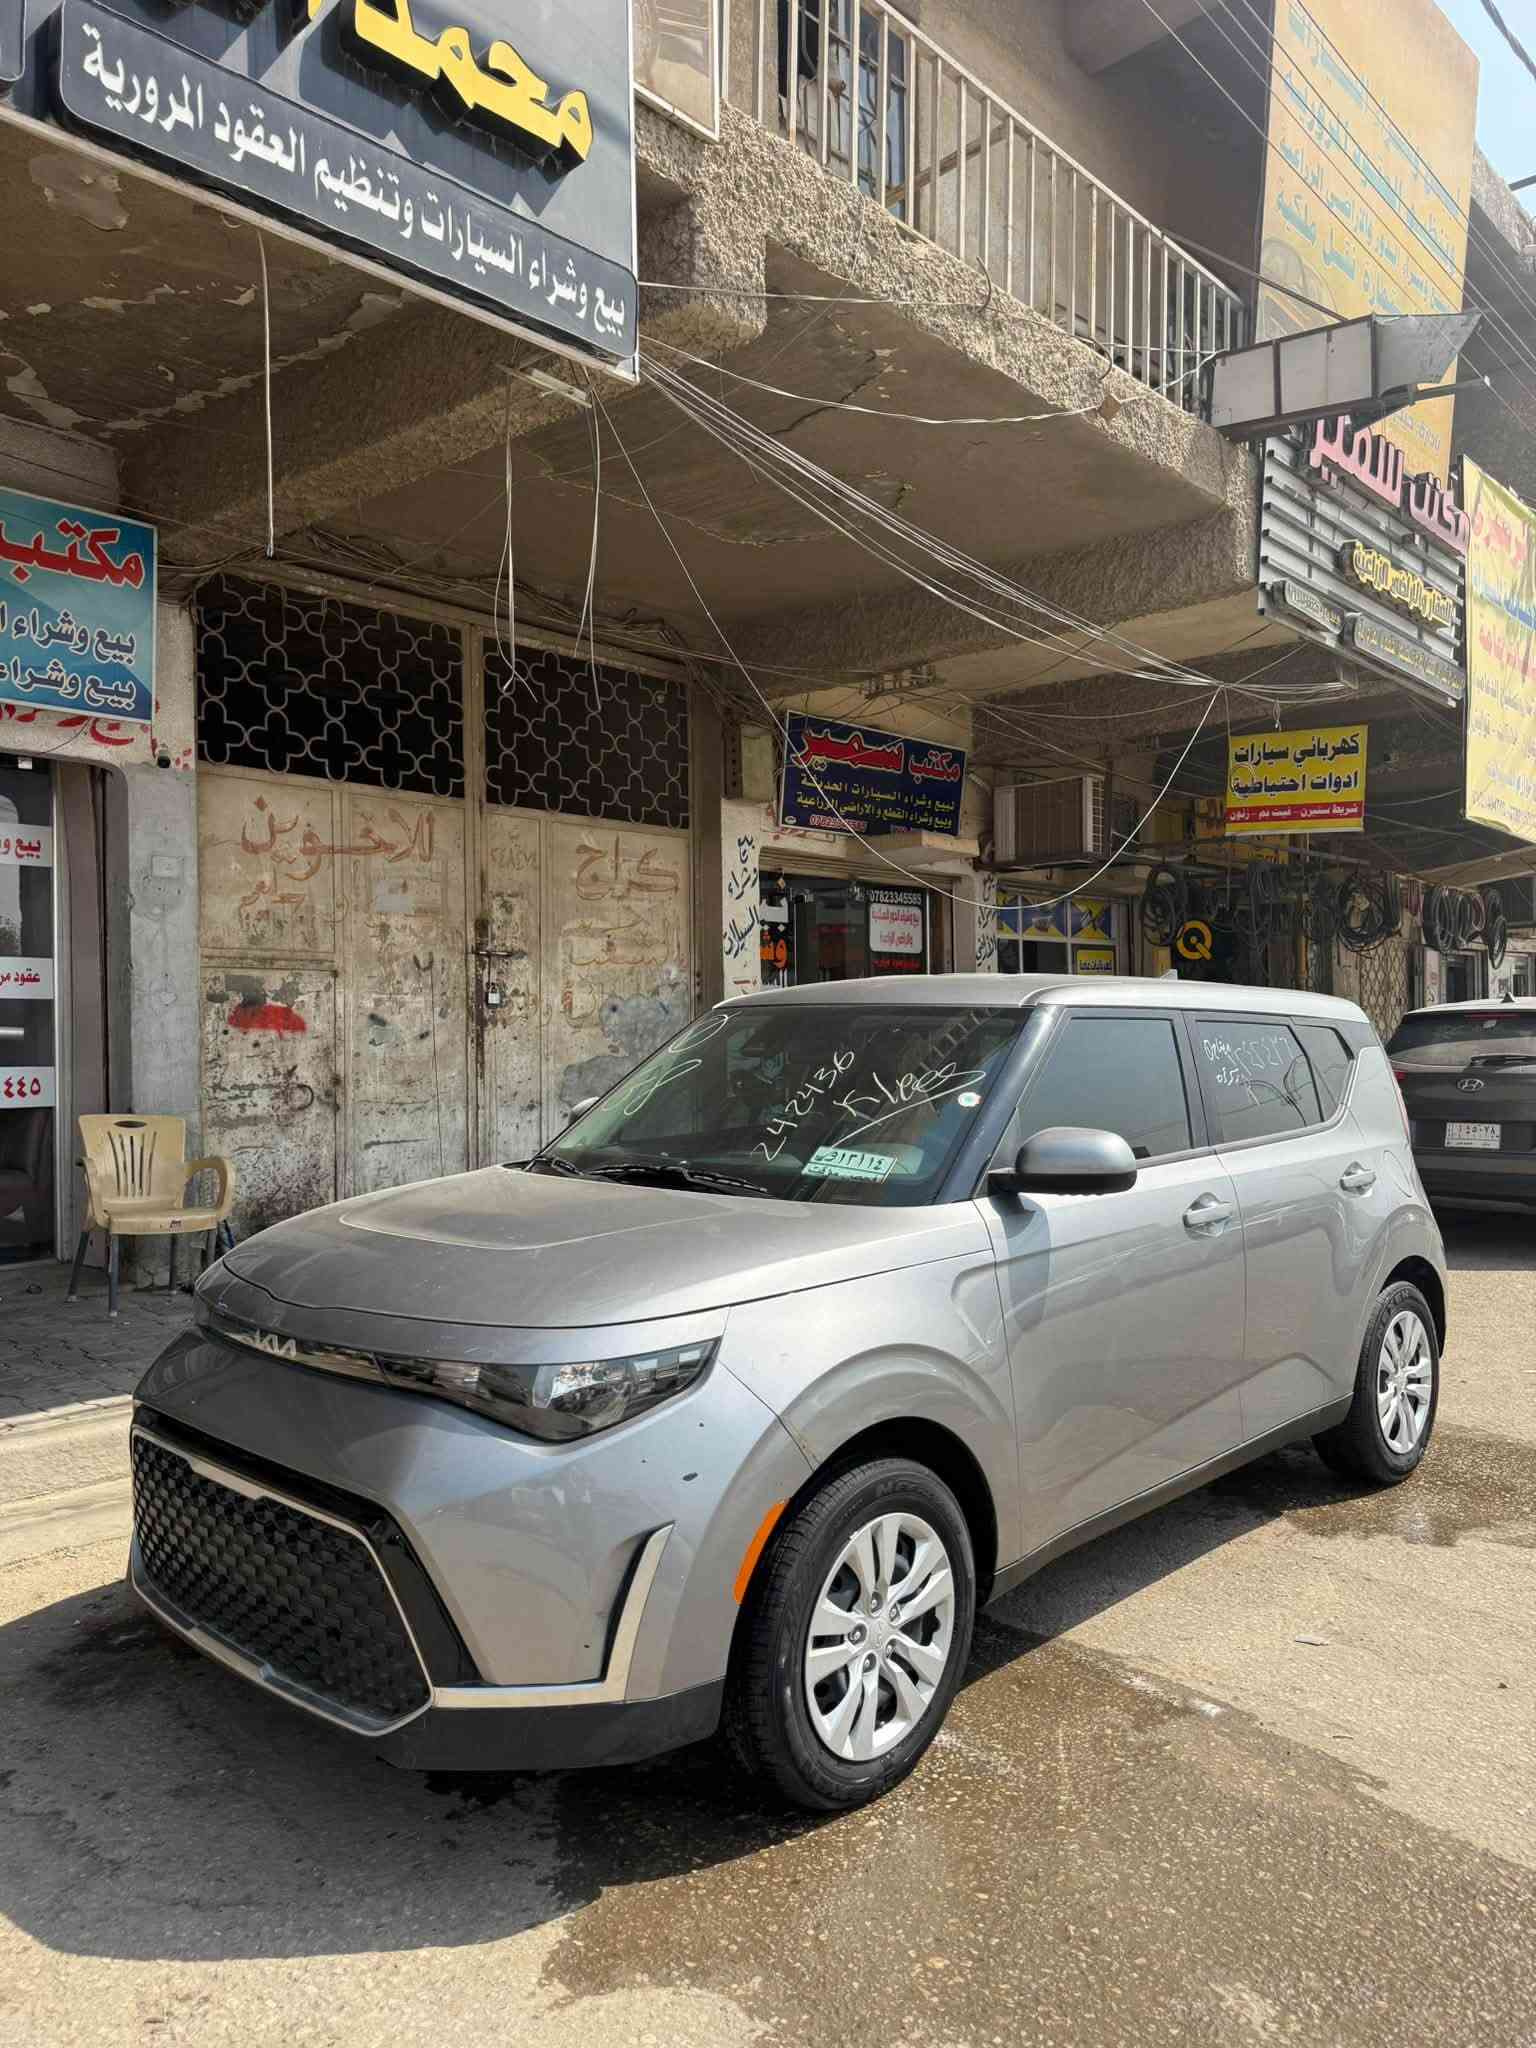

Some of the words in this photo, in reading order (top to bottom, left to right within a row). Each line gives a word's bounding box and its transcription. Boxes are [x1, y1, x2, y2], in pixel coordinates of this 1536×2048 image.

[82, 23, 204, 135] المرورية
[214, 100, 307, 176] العقود
[312, 154, 416, 241] وتنظيم
[420, 190, 524, 278] السيارات
[528, 257, 589, 320] وشراء
[593, 296, 626, 337] بيع
[12, 608, 90, 655] وشراء
[94, 629, 136, 664] بيع
[85, 674, 136, 710] بيع
[1234, 741, 1289, 766] سيارات
[1232, 773, 1306, 798] احتياطية
[1311, 771, 1358, 793] ادوات
[15, 837, 42, 859] بيع
[14, 967, 41, 987] عقود
